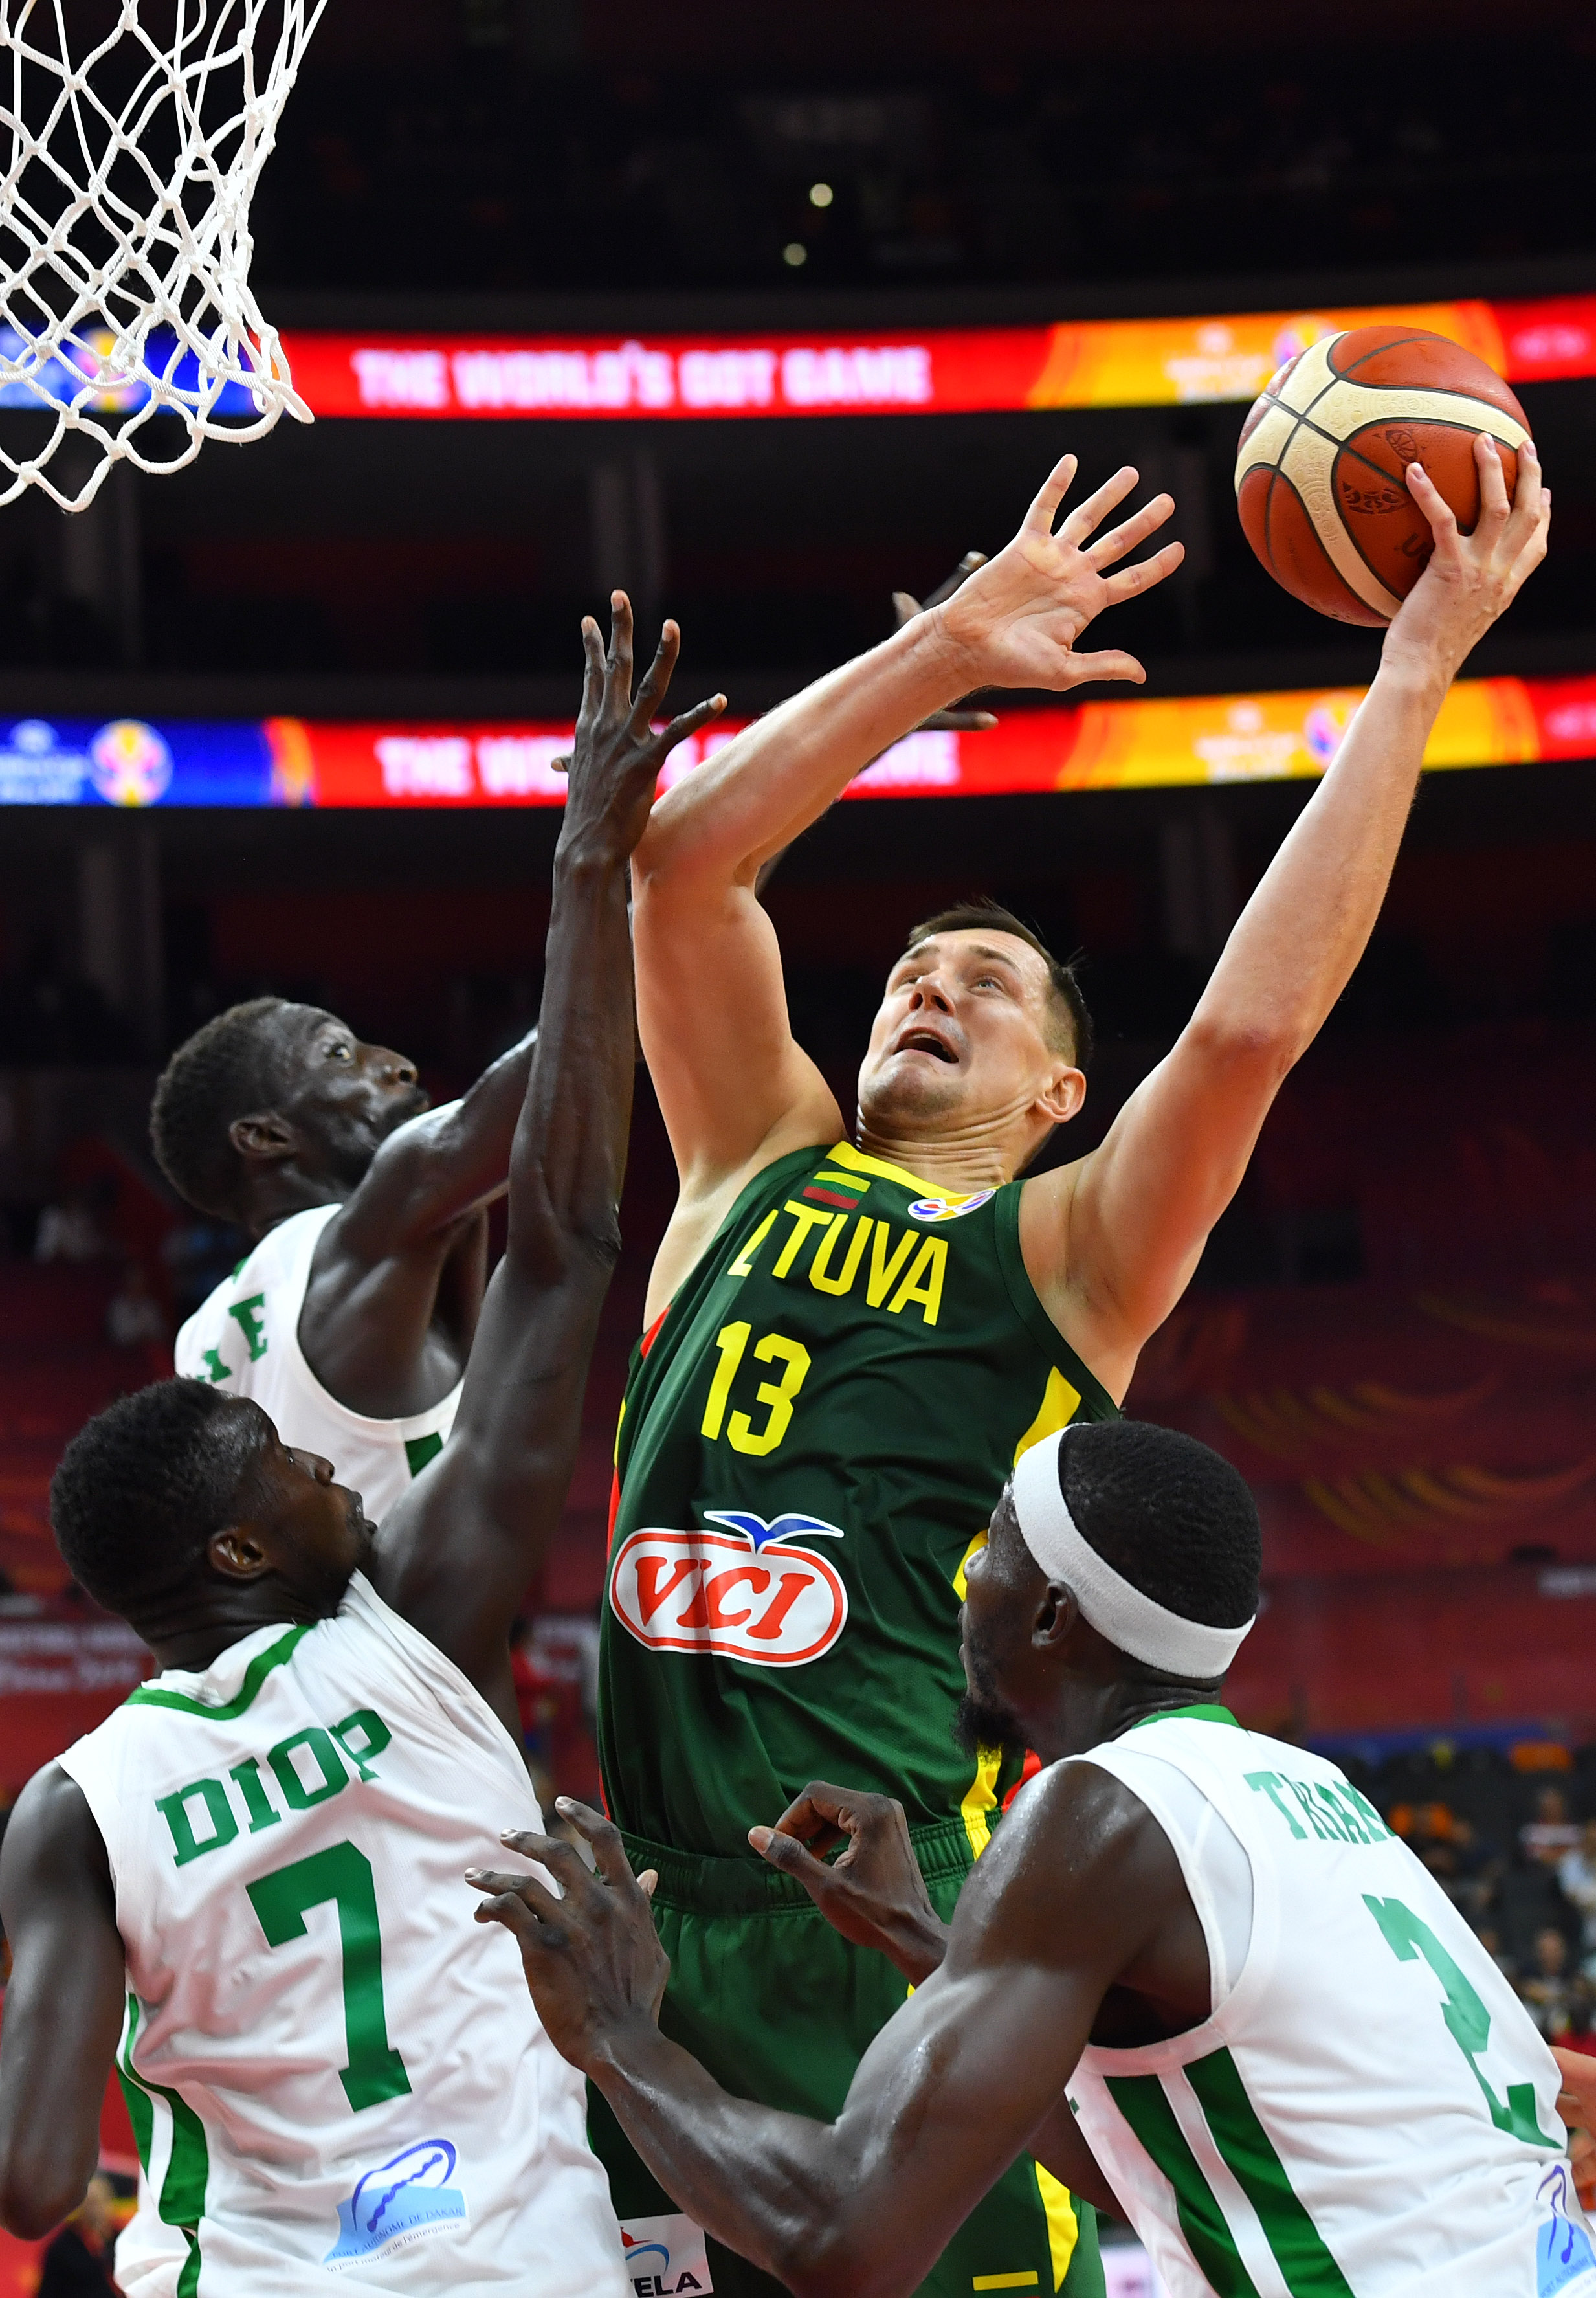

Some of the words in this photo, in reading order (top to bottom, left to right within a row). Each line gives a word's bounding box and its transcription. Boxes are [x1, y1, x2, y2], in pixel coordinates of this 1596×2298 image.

[351, 348, 449, 408] THE
[701, 1321, 812, 1456] 13
[634, 1556, 815, 1640] VICI
[155, 1708, 392, 1868] DIOP
[246, 1840, 413, 2114] 7
[1361, 1893, 1564, 2149] 2
